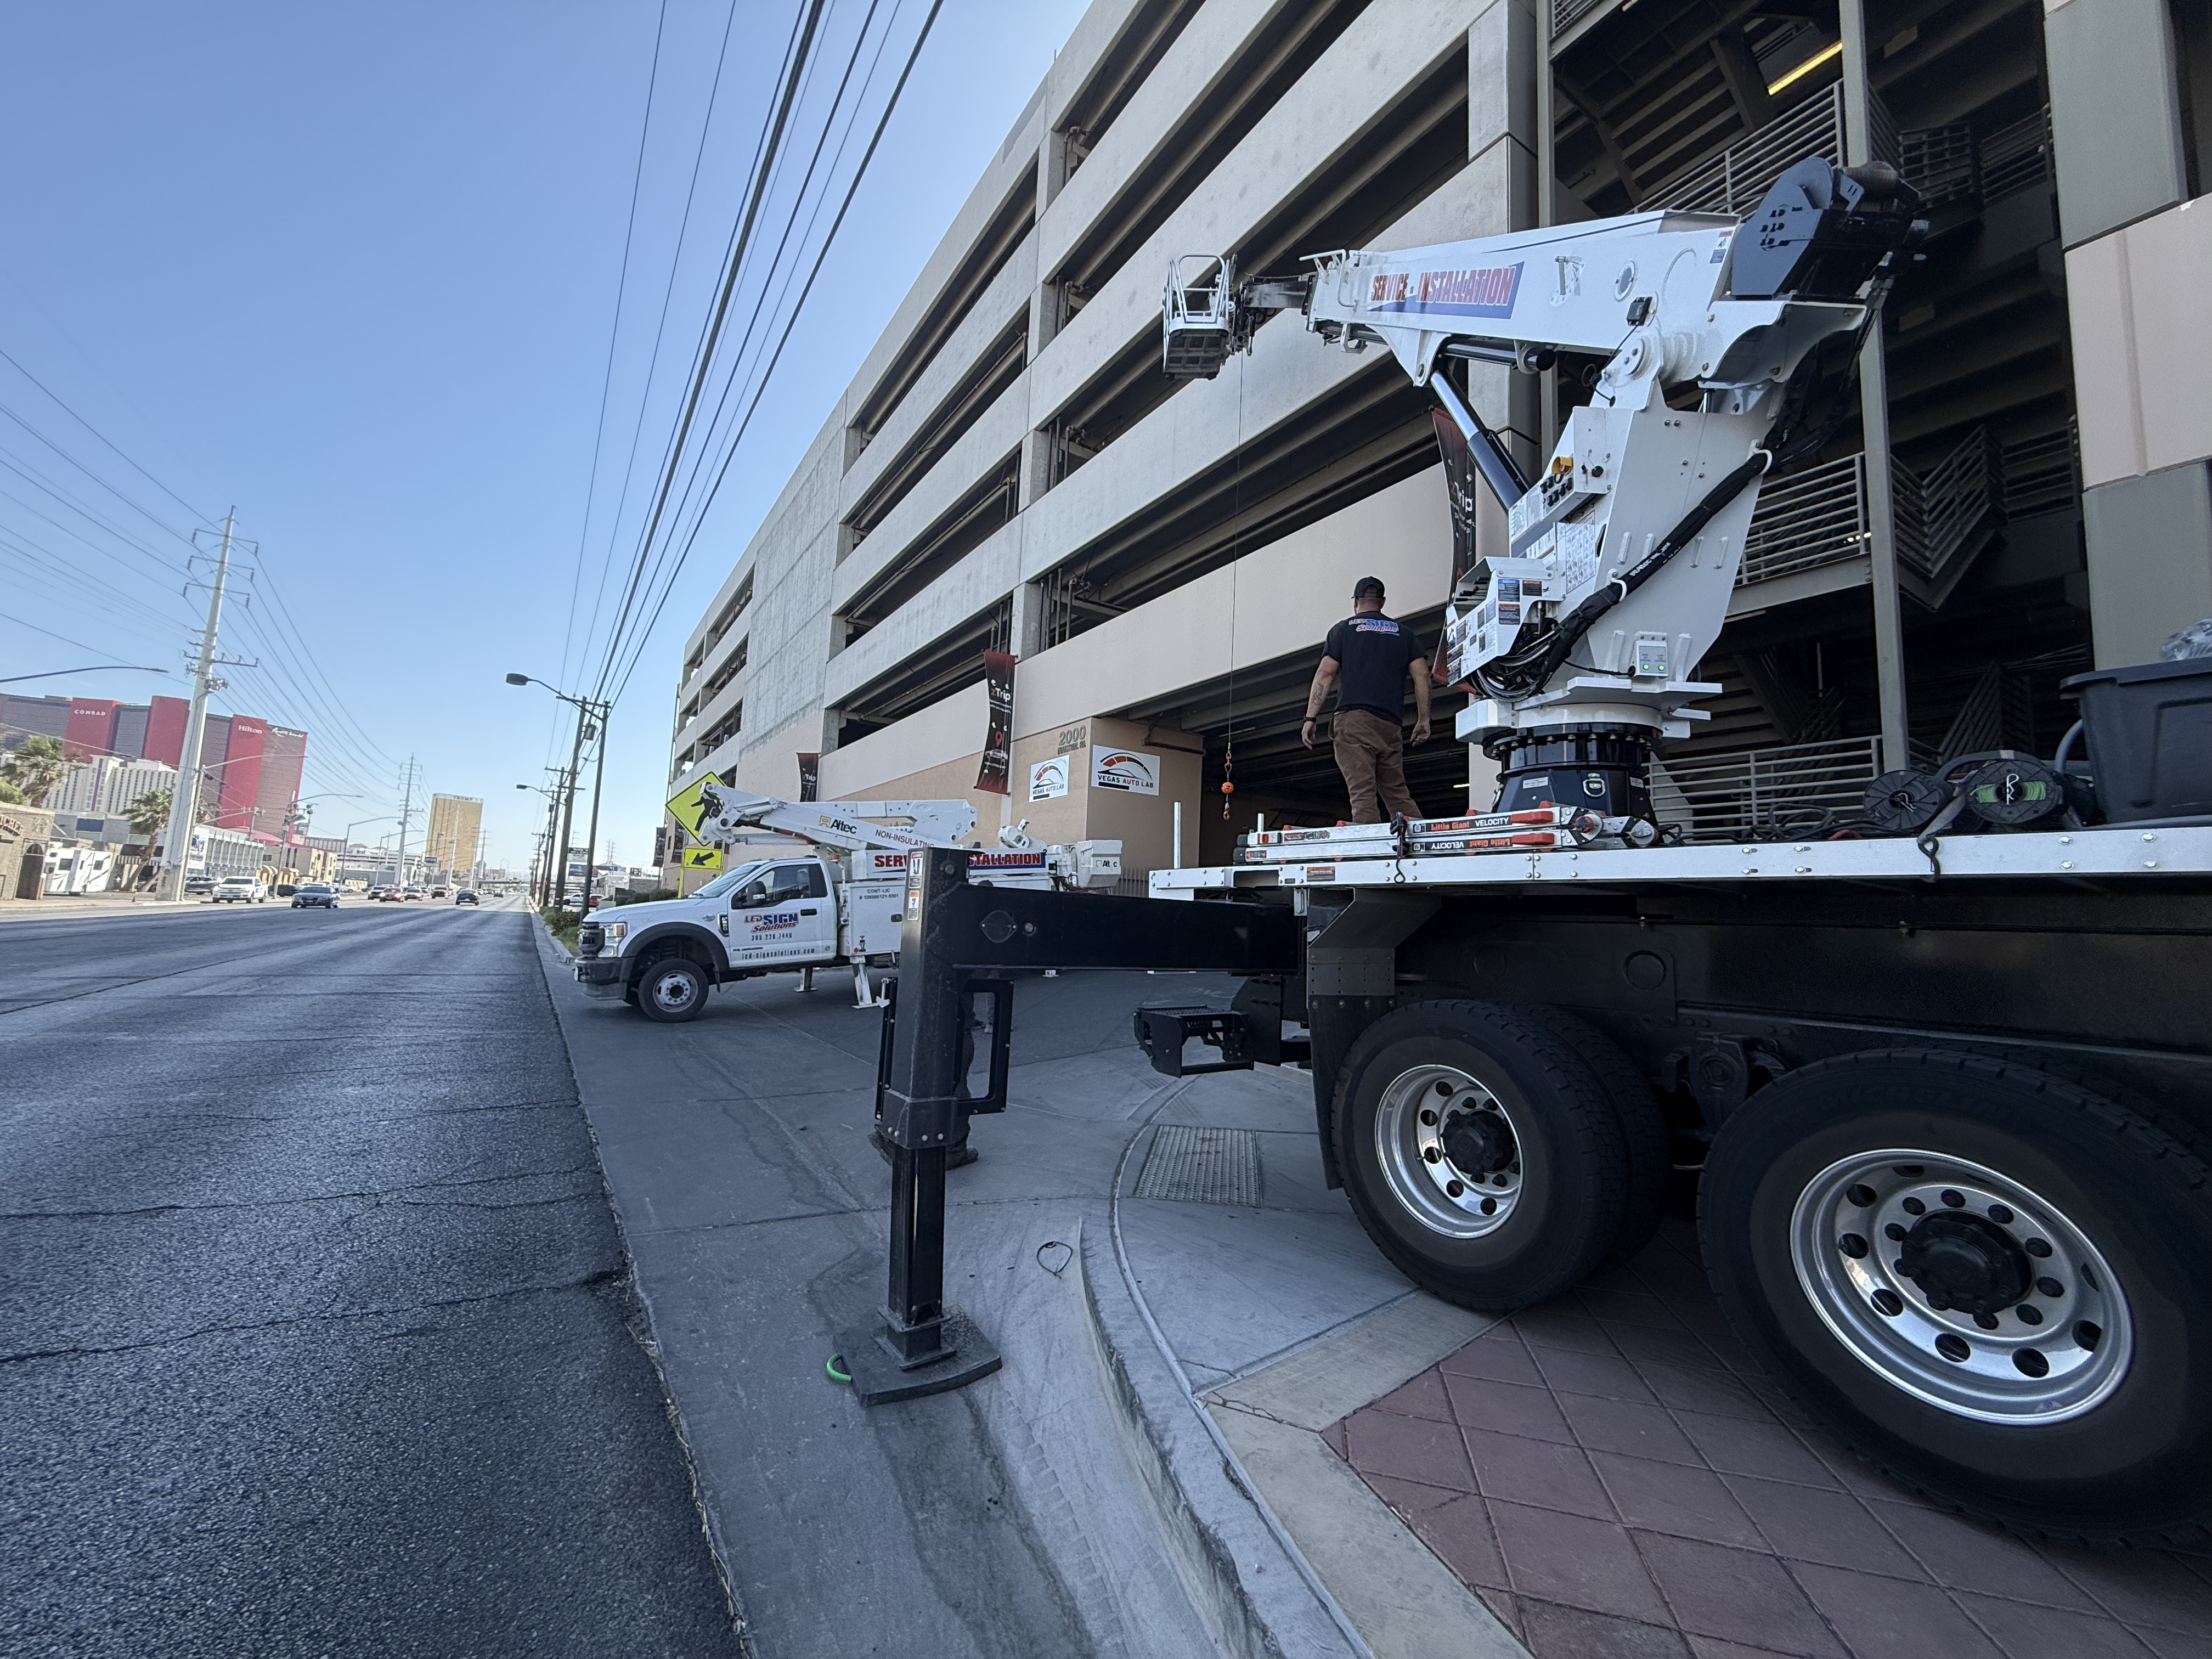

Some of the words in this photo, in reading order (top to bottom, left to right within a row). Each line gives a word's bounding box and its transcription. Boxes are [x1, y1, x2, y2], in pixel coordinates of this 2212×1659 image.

[1372, 273, 1409, 301] SERVICE
[1416, 266, 1516, 306] INSTALLATION
[1366, 619, 1398, 628] SIGN
[991, 687, 1011, 702] zTrip
[238, 725, 262, 734] Hilton
[1059, 725, 1086, 746] 2000
[1098, 775, 1120, 783] VEGAS
[830, 819, 857, 834] Altec
[1475, 817, 1509, 827] VELOCITY
[763, 913, 798, 926] SIGN
[752, 921, 797, 933] Solutions
